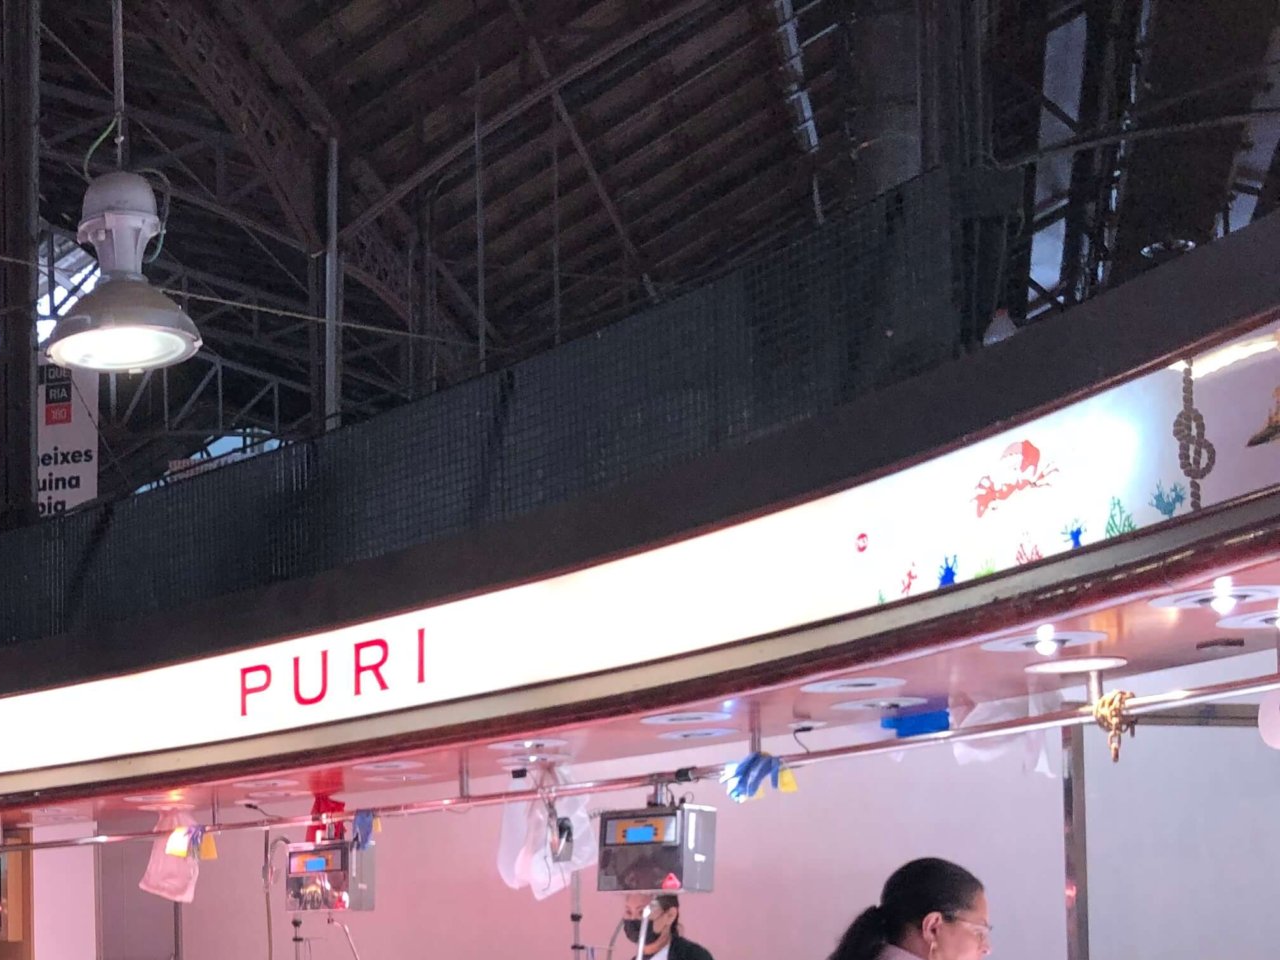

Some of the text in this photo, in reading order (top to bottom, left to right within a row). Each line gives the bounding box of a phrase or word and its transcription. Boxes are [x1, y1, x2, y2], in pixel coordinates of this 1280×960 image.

[49, 388, 68, 400] RIA
[38, 446, 93, 467] eixes
[240, 628, 425, 716] PURI
